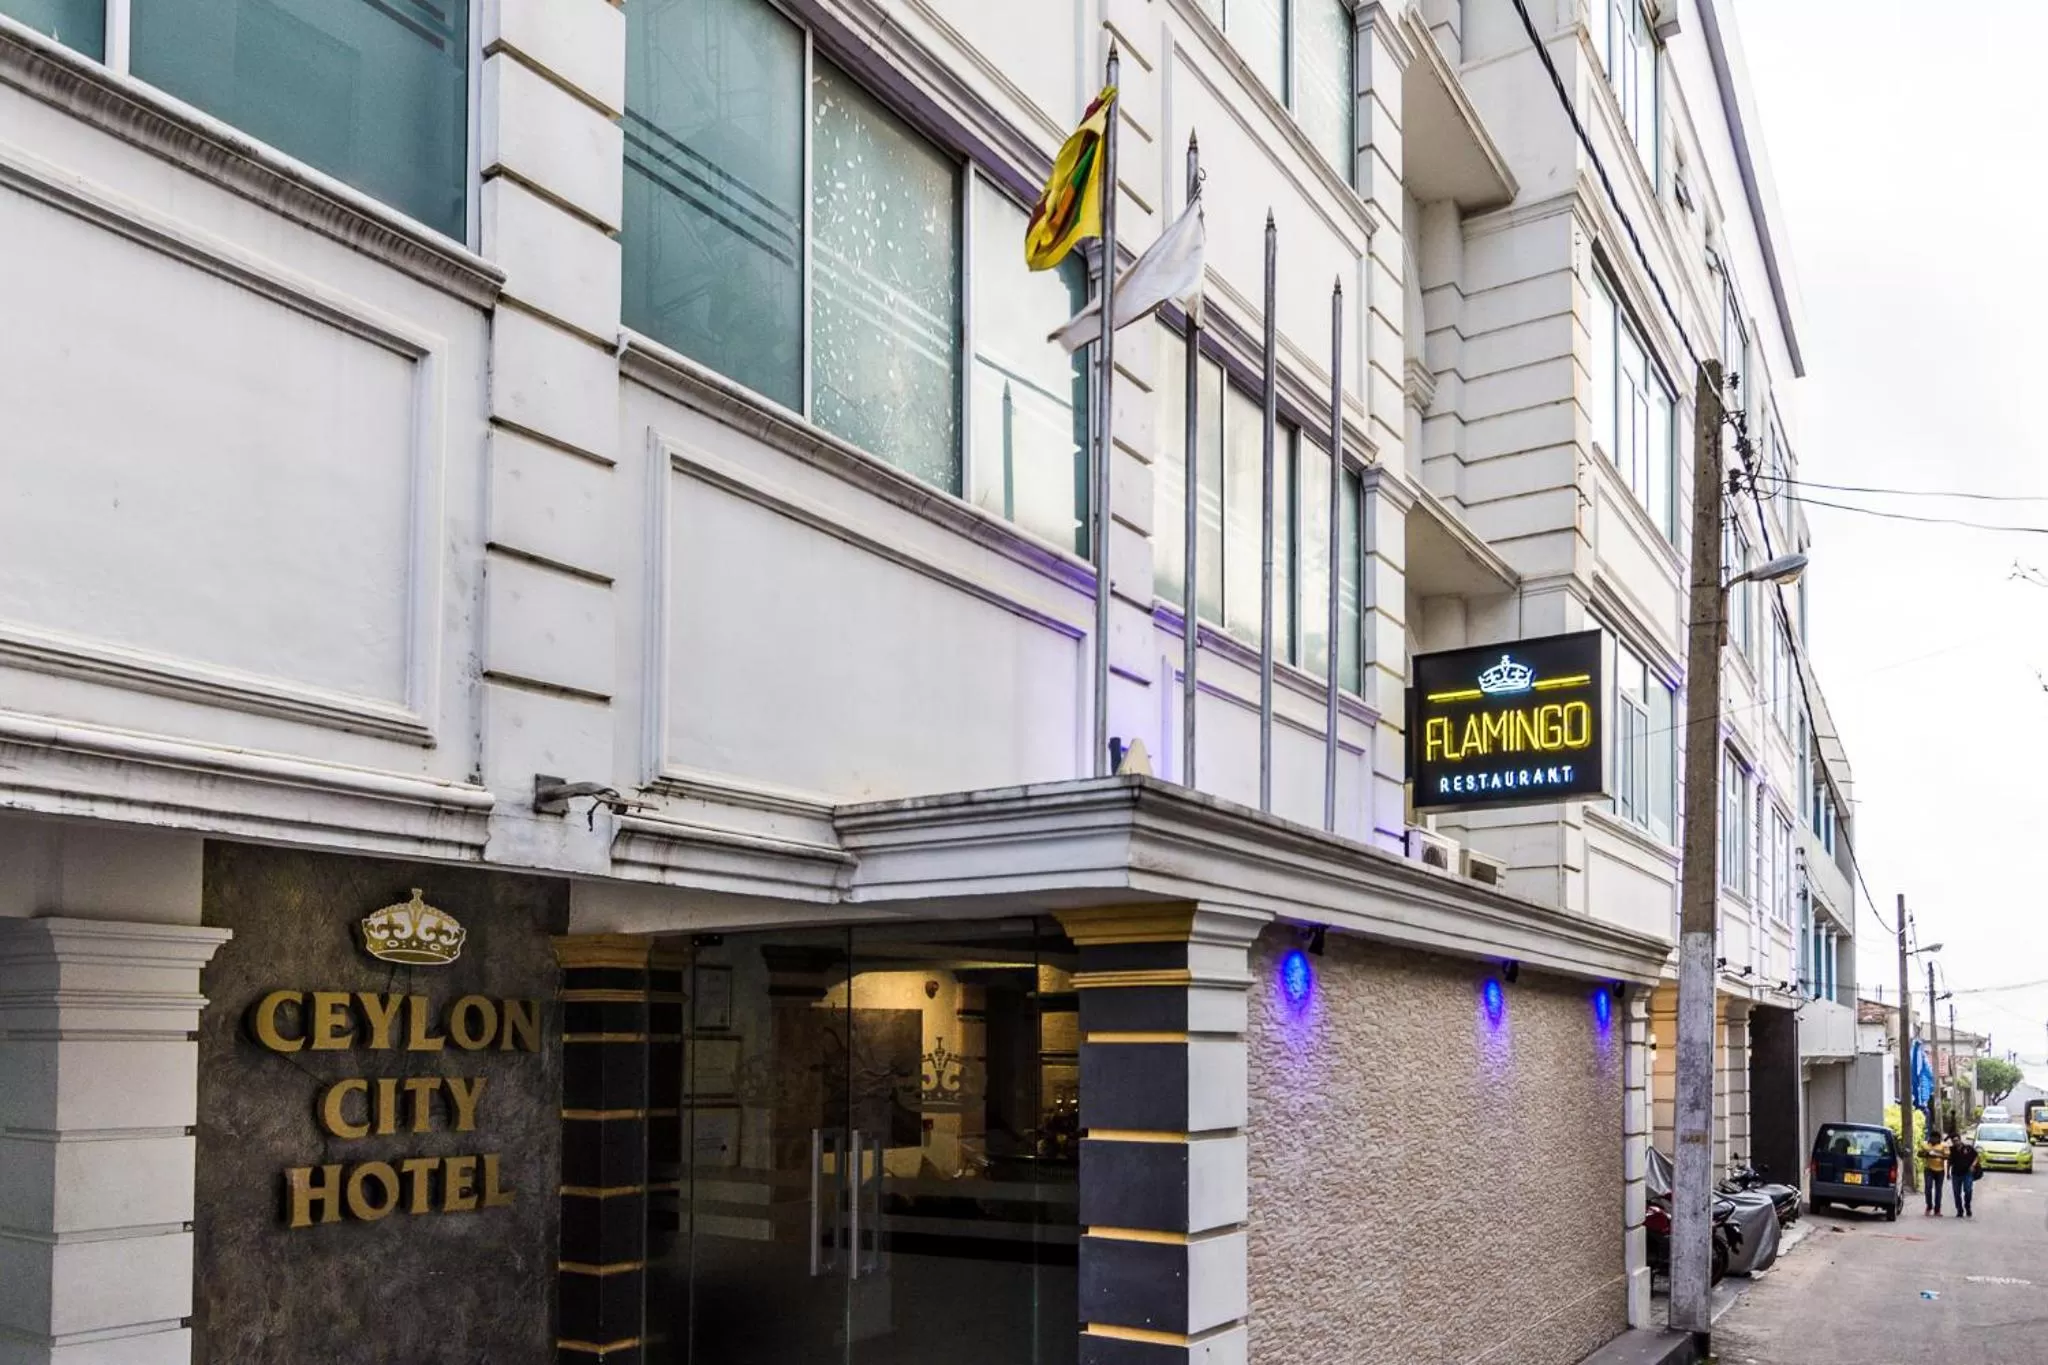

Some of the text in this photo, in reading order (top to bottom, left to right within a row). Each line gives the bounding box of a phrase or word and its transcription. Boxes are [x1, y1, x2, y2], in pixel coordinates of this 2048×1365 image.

[1426, 701, 1590, 761] FLAMINGO
[1440, 765, 1573, 793] RESTAURANT
[256, 990, 540, 1052] CEYLON
[324, 1077, 487, 1138] CITY
[287, 1154, 514, 1228] HOTEL
